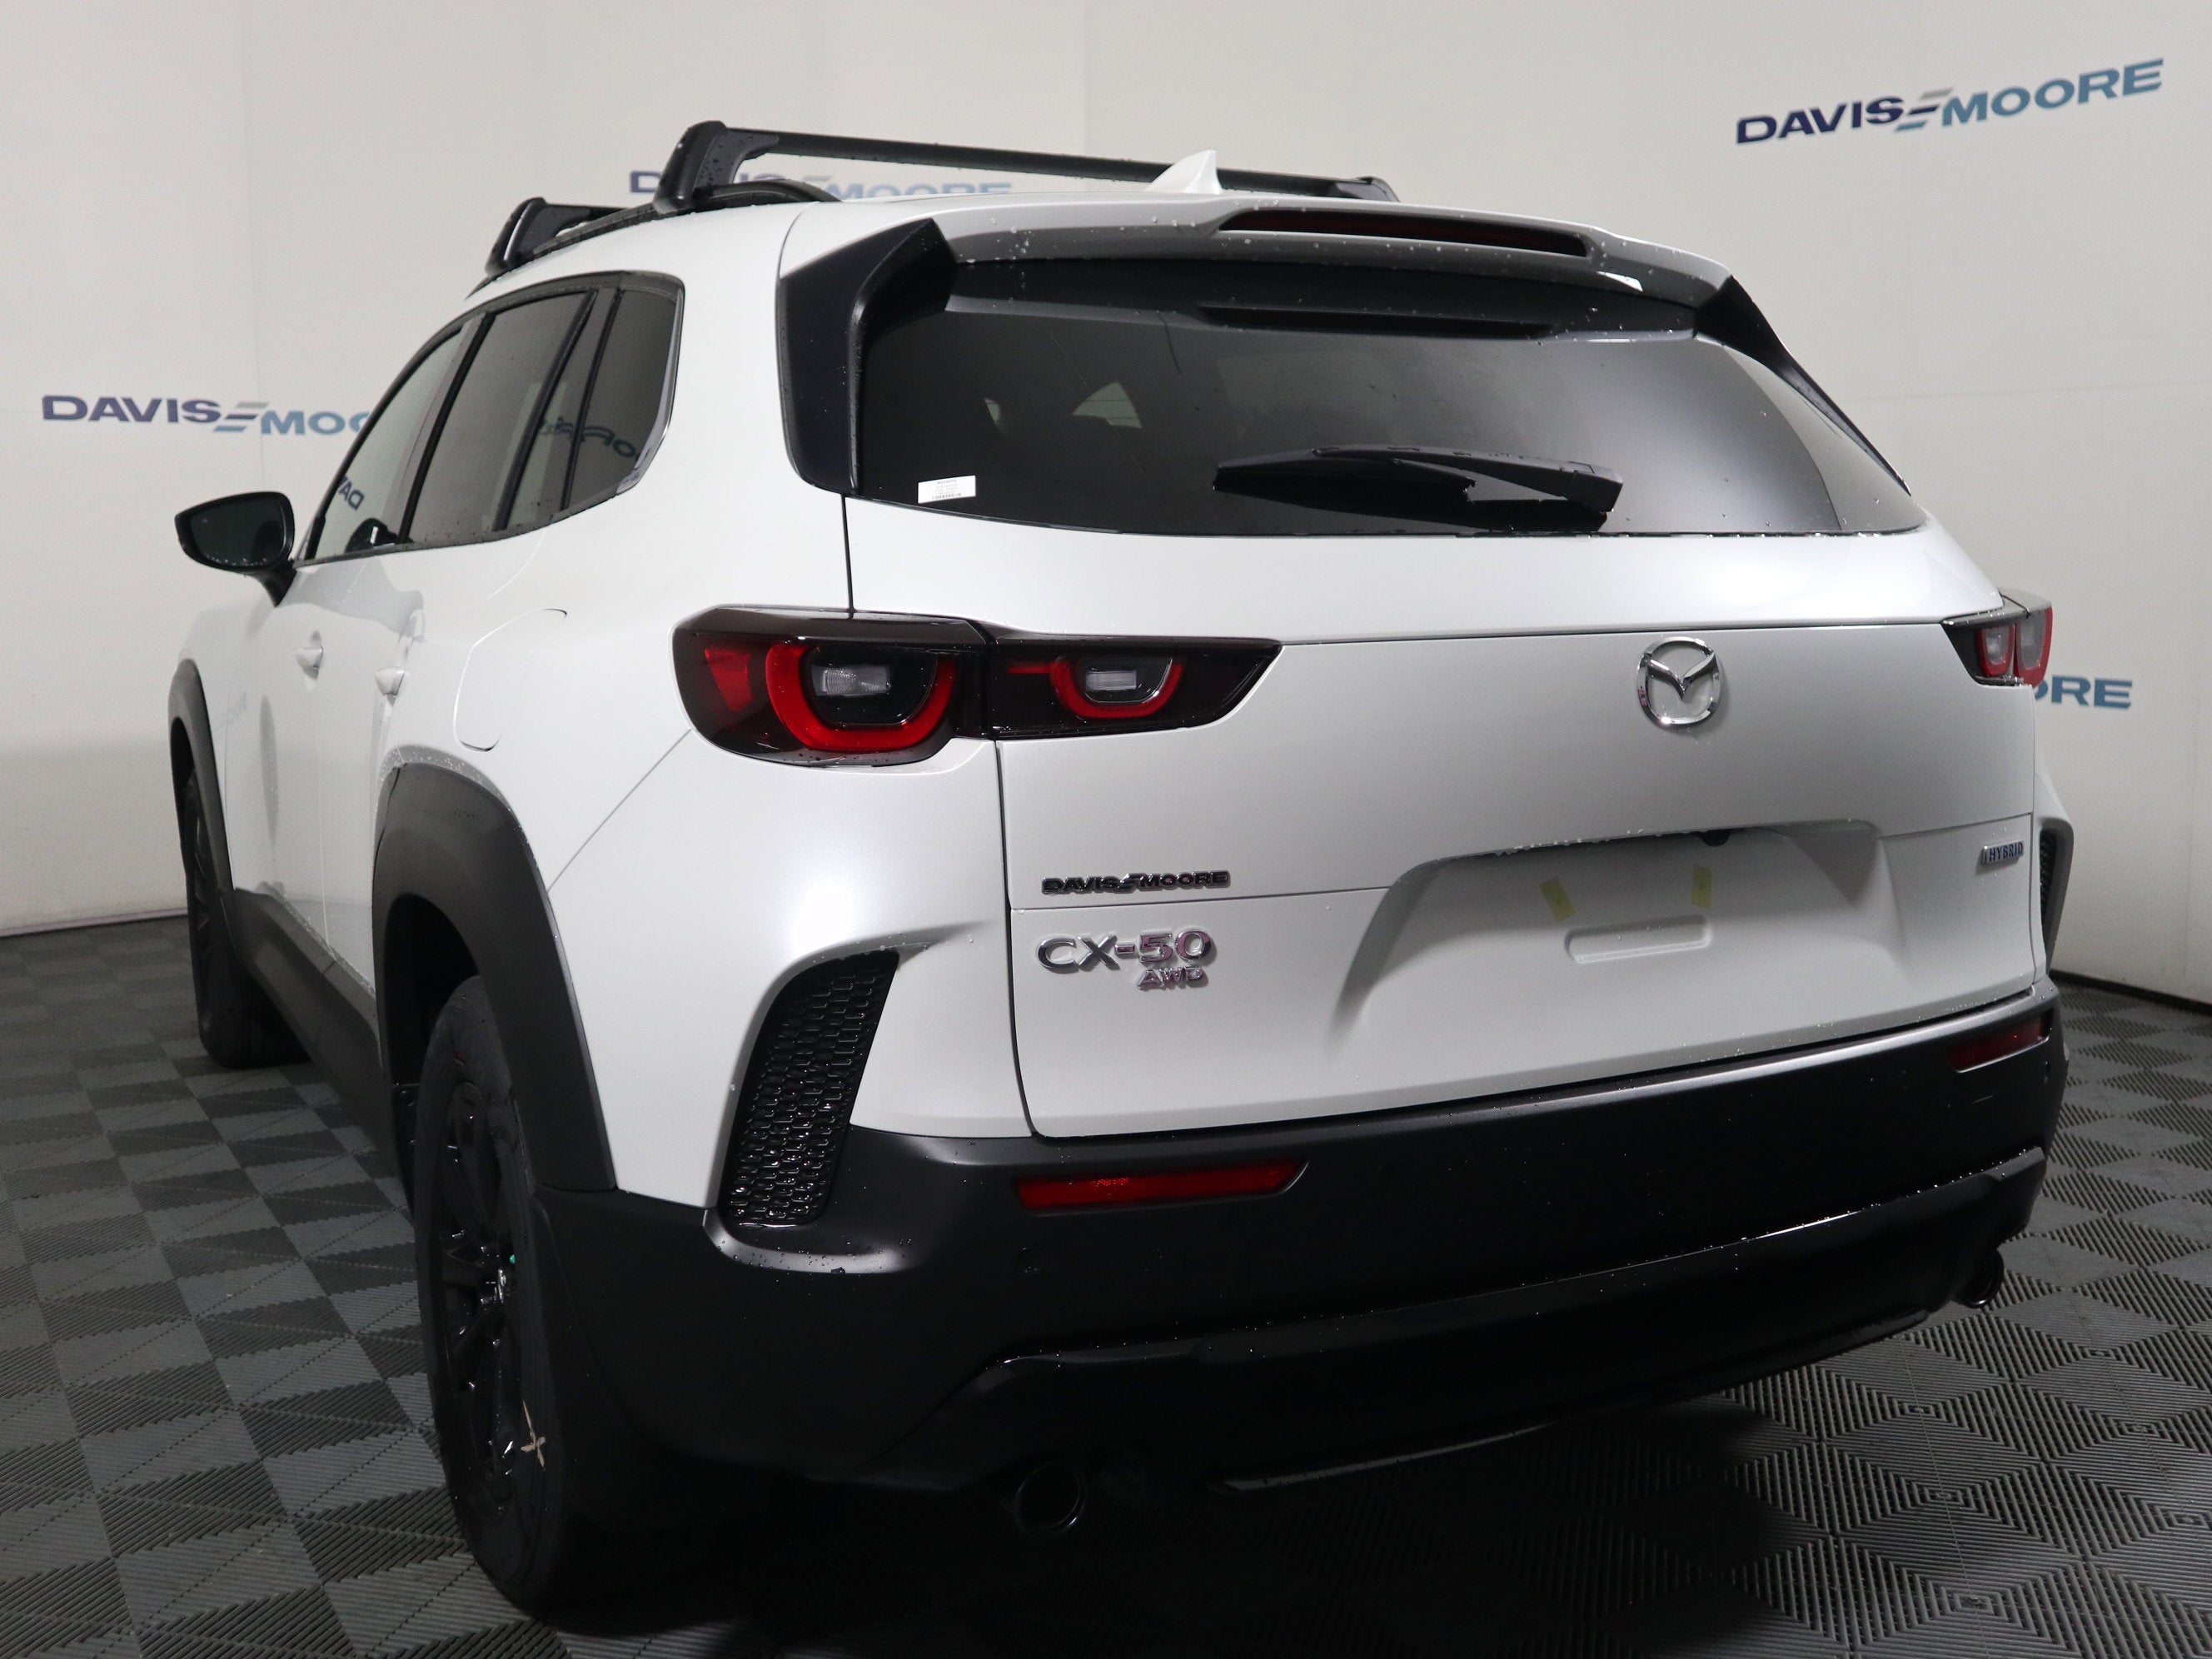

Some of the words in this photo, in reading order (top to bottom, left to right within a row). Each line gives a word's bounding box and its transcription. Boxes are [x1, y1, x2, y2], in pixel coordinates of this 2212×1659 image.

[1736, 96, 1905, 145] DAVIS
[1942, 57, 2165, 127] MOORE
[42, 394, 222, 422] DAVIS
[1989, 841, 2024, 862] HYBRID
[1037, 926, 1213, 973] CX-50
[1137, 965, 1205, 990] AWD
